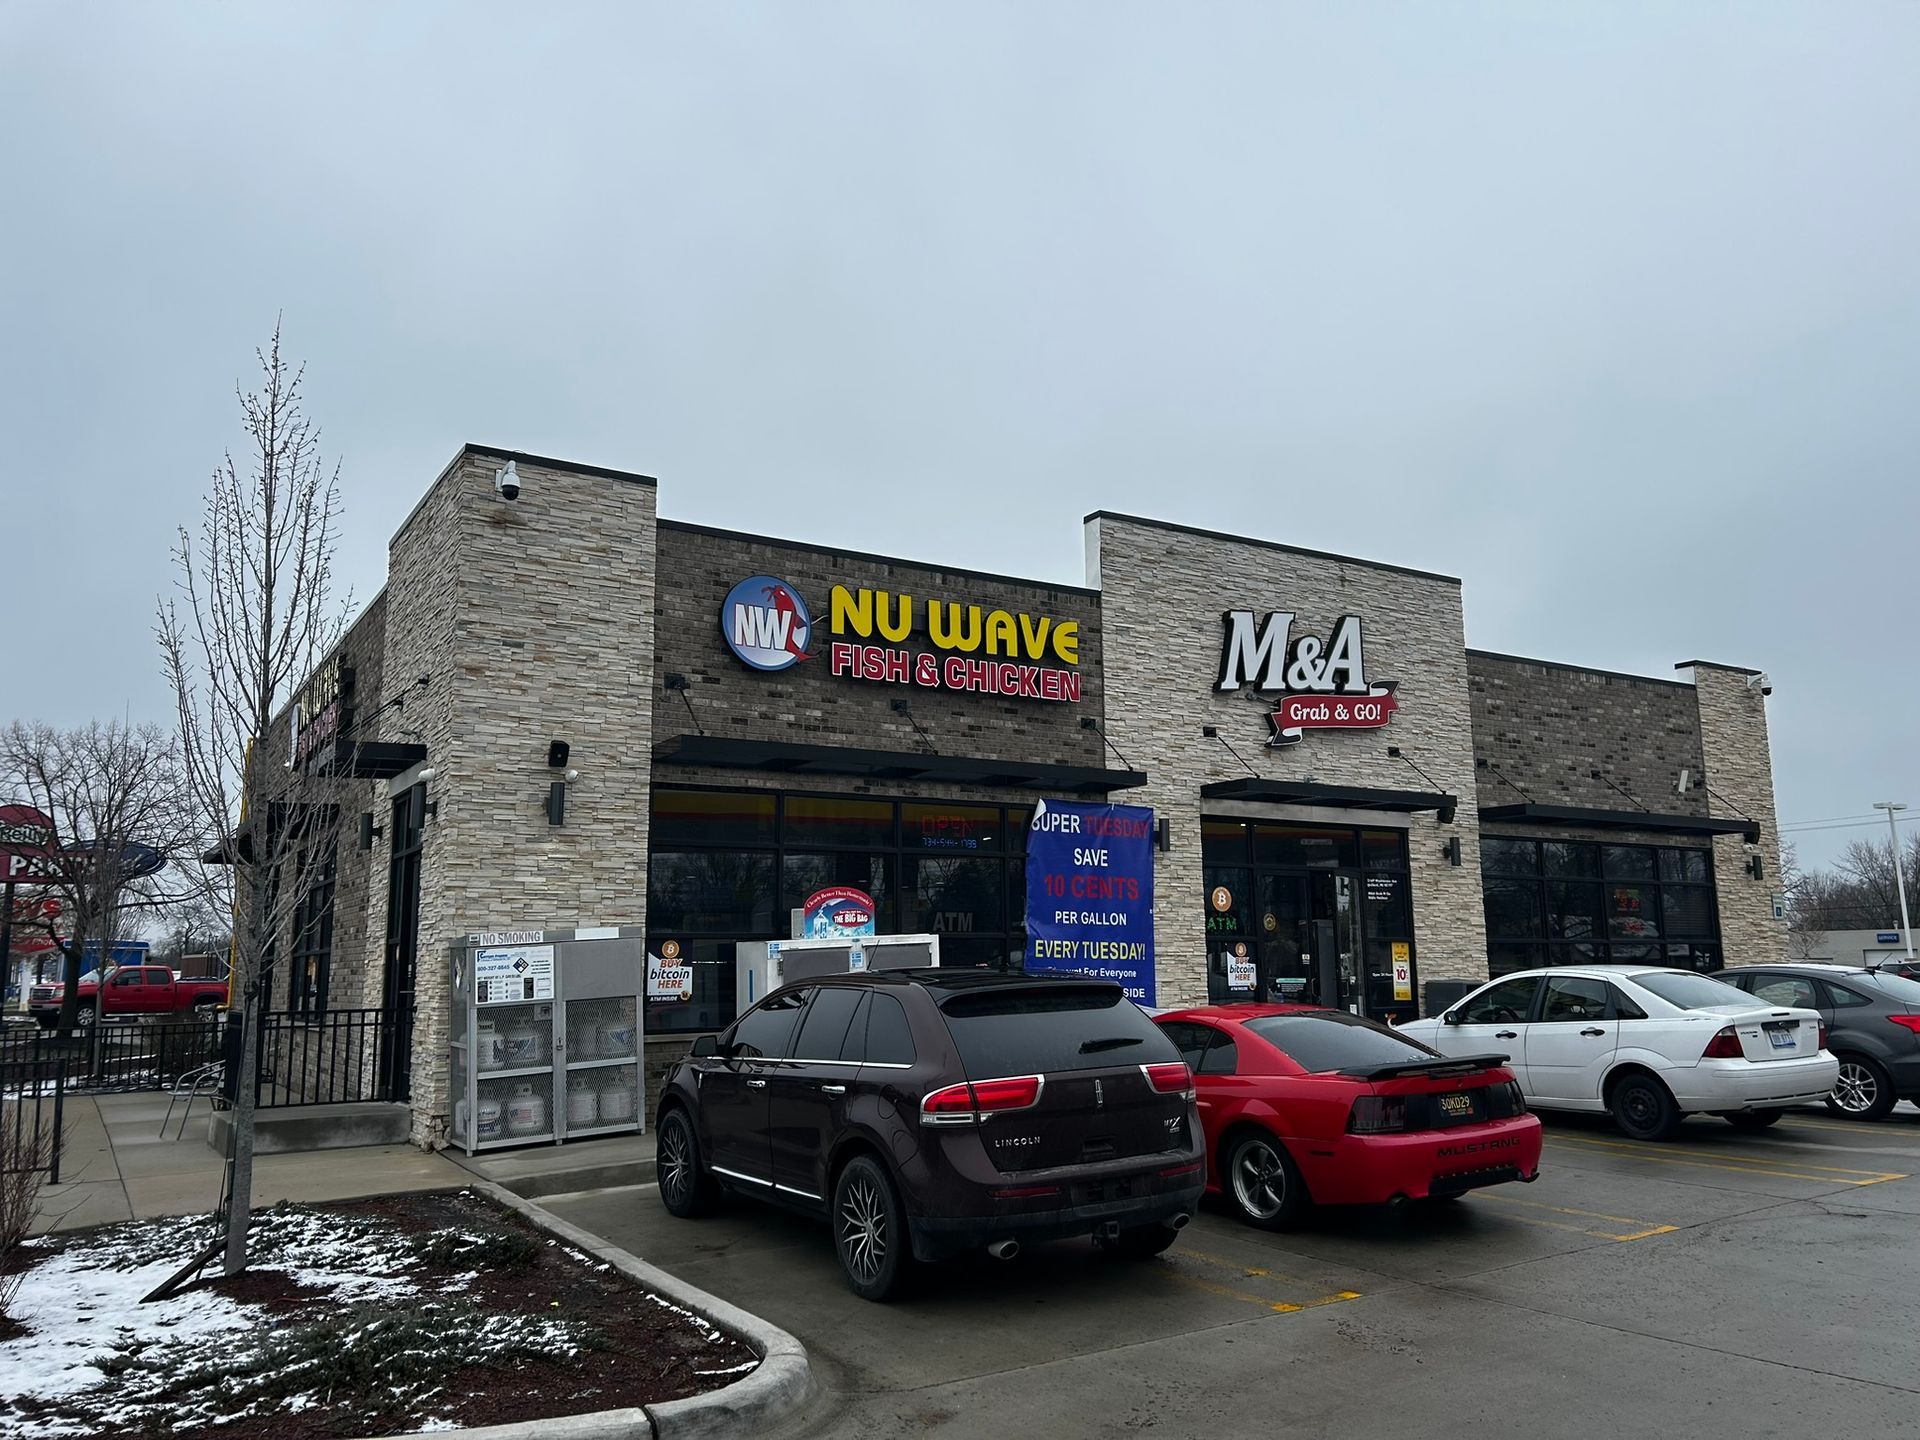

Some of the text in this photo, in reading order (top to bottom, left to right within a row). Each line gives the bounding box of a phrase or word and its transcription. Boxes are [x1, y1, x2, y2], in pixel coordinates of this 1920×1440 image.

[734, 603, 792, 650] NW
[830, 584, 1079, 665] NU WAVE
[1216, 610, 1369, 692] M&A
[831, 642, 1081, 703] FISH & CHICKEN
[1290, 703, 1381, 720] Grab & GO!
[922, 816, 972, 837] OPEN
[1031, 812, 1149, 839] SUPER TUESDAY
[1073, 848, 1108, 867] SAVE
[1044, 874, 1139, 900] 10 CENTS
[834, 913, 868, 923] THE BIG BAG
[933, 911, 973, 932] ATM
[1055, 911, 1127, 926] PER GALLON
[1207, 917, 1237, 930] ATM
[482, 931, 541, 945] NO SMOKING
[1035, 940, 1146, 960] EVERY TUESDAY!
[660, 959, 680, 968] BUY
[1230, 964, 1255, 974] bitcoin
[650, 968, 690, 980] bitcoin
[1083, 967, 1098, 976] For
[1100, 968, 1136, 979] Everyone
[657, 980, 684, 989] HERE
[1122, 987, 1145, 998] SIDE
[994, 1136, 1041, 1148] LINCOLN
[1437, 1137, 1520, 1157] MUSTANG
